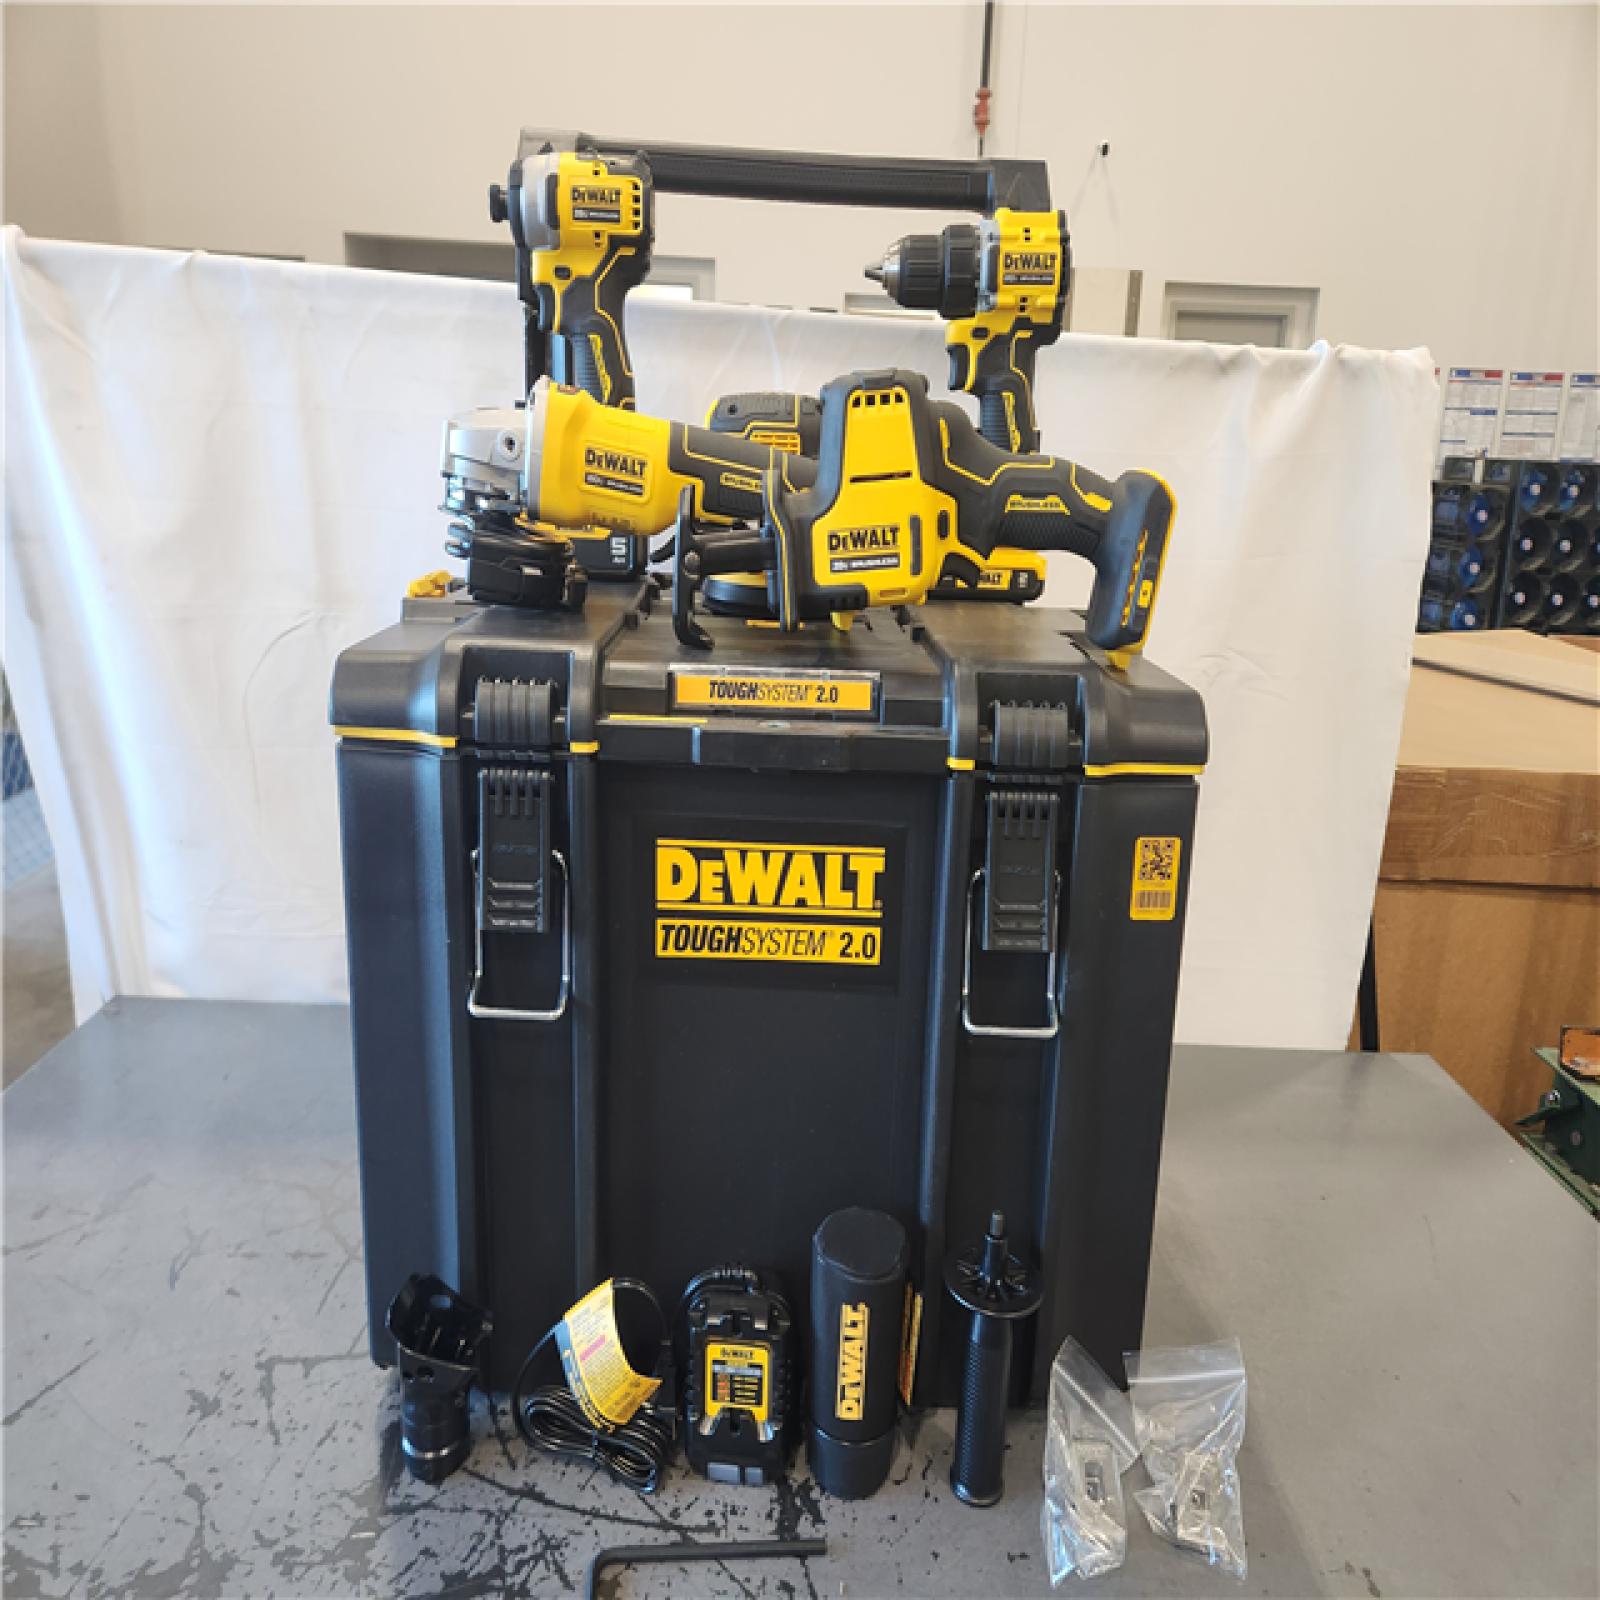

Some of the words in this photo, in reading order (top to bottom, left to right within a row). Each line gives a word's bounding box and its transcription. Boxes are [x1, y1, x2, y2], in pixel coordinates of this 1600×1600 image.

[815, 685, 839, 703] 2.0
[656, 847, 885, 909] DEWALT
[839, 931, 876, 960] 2.0
